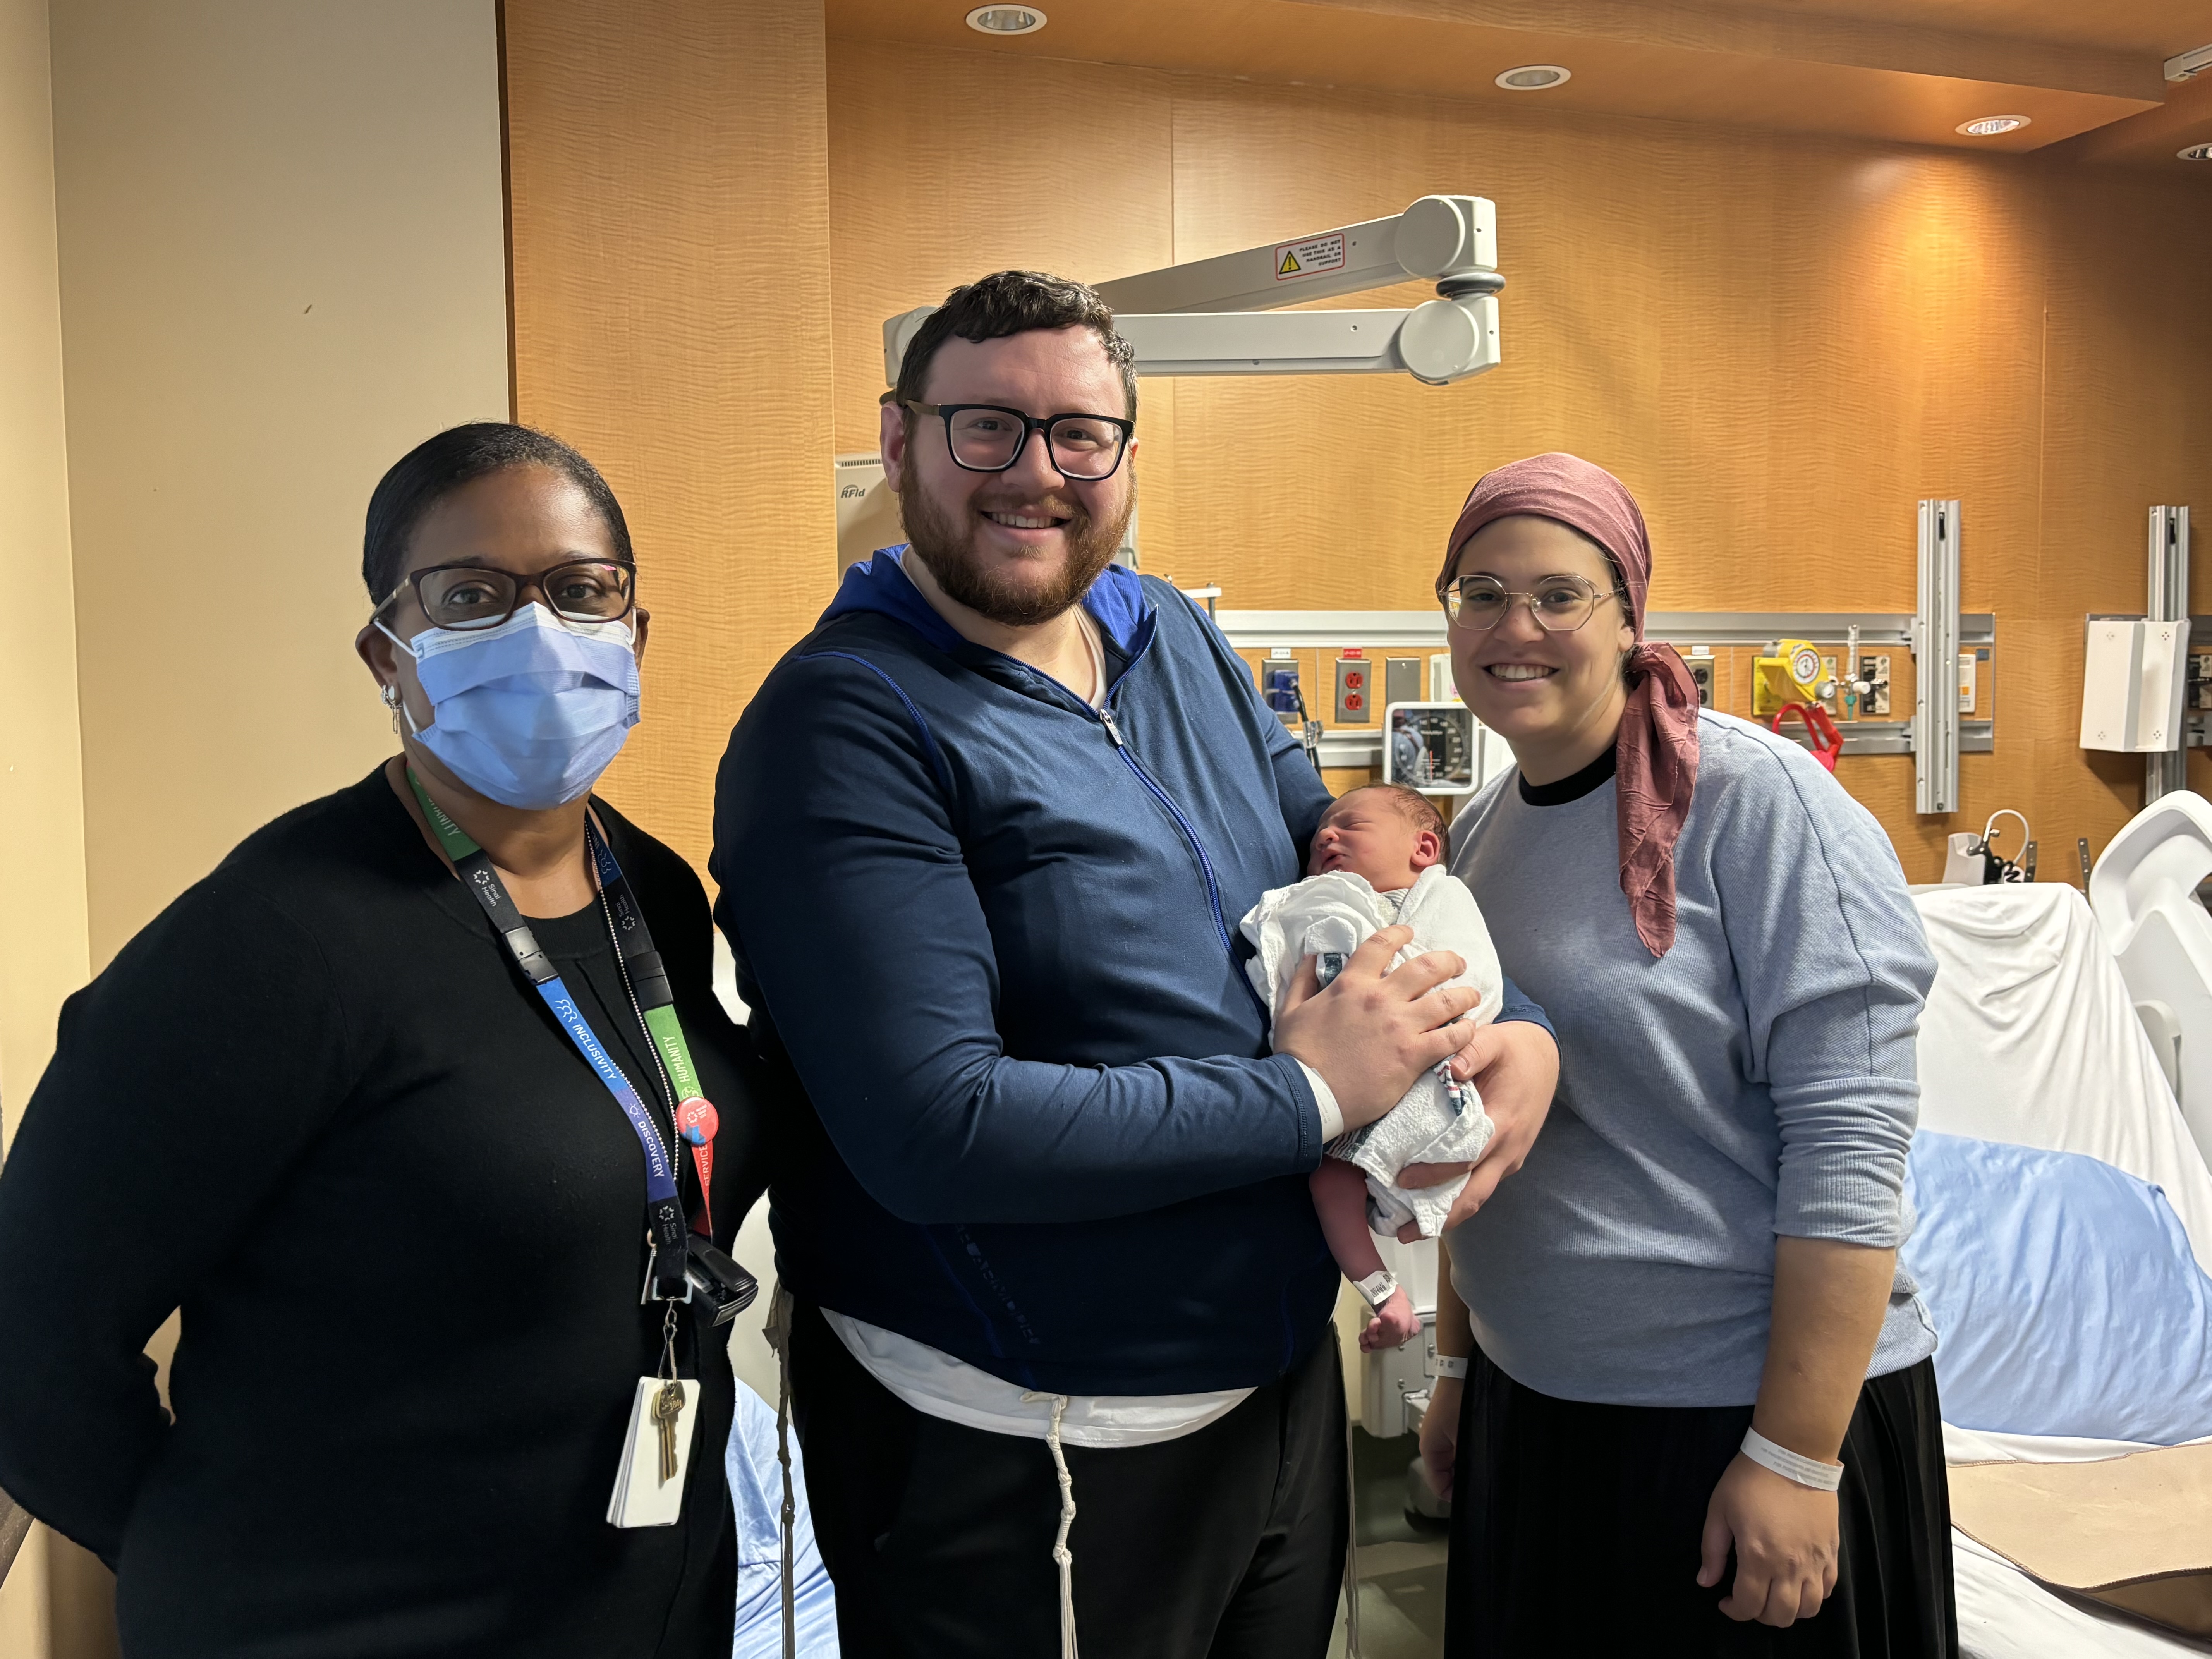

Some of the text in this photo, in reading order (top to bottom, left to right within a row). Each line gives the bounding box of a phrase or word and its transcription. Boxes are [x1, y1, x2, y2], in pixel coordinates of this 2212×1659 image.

[1306, 254, 1331, 262] HANDRAIL
[1318, 258, 1341, 266] SUPPORT
[482, 886, 497, 906] Health
[488, 884, 501, 899] Sinai
[620, 894, 630, 914] Health
[572, 1024, 617, 1079] INCLUSIVITY
[663, 1037, 690, 1082] HUMANITY
[638, 1121, 665, 1177] DISCOVERY
[662, 1224, 672, 1245] Health
[670, 1223, 678, 1239] Sinai
